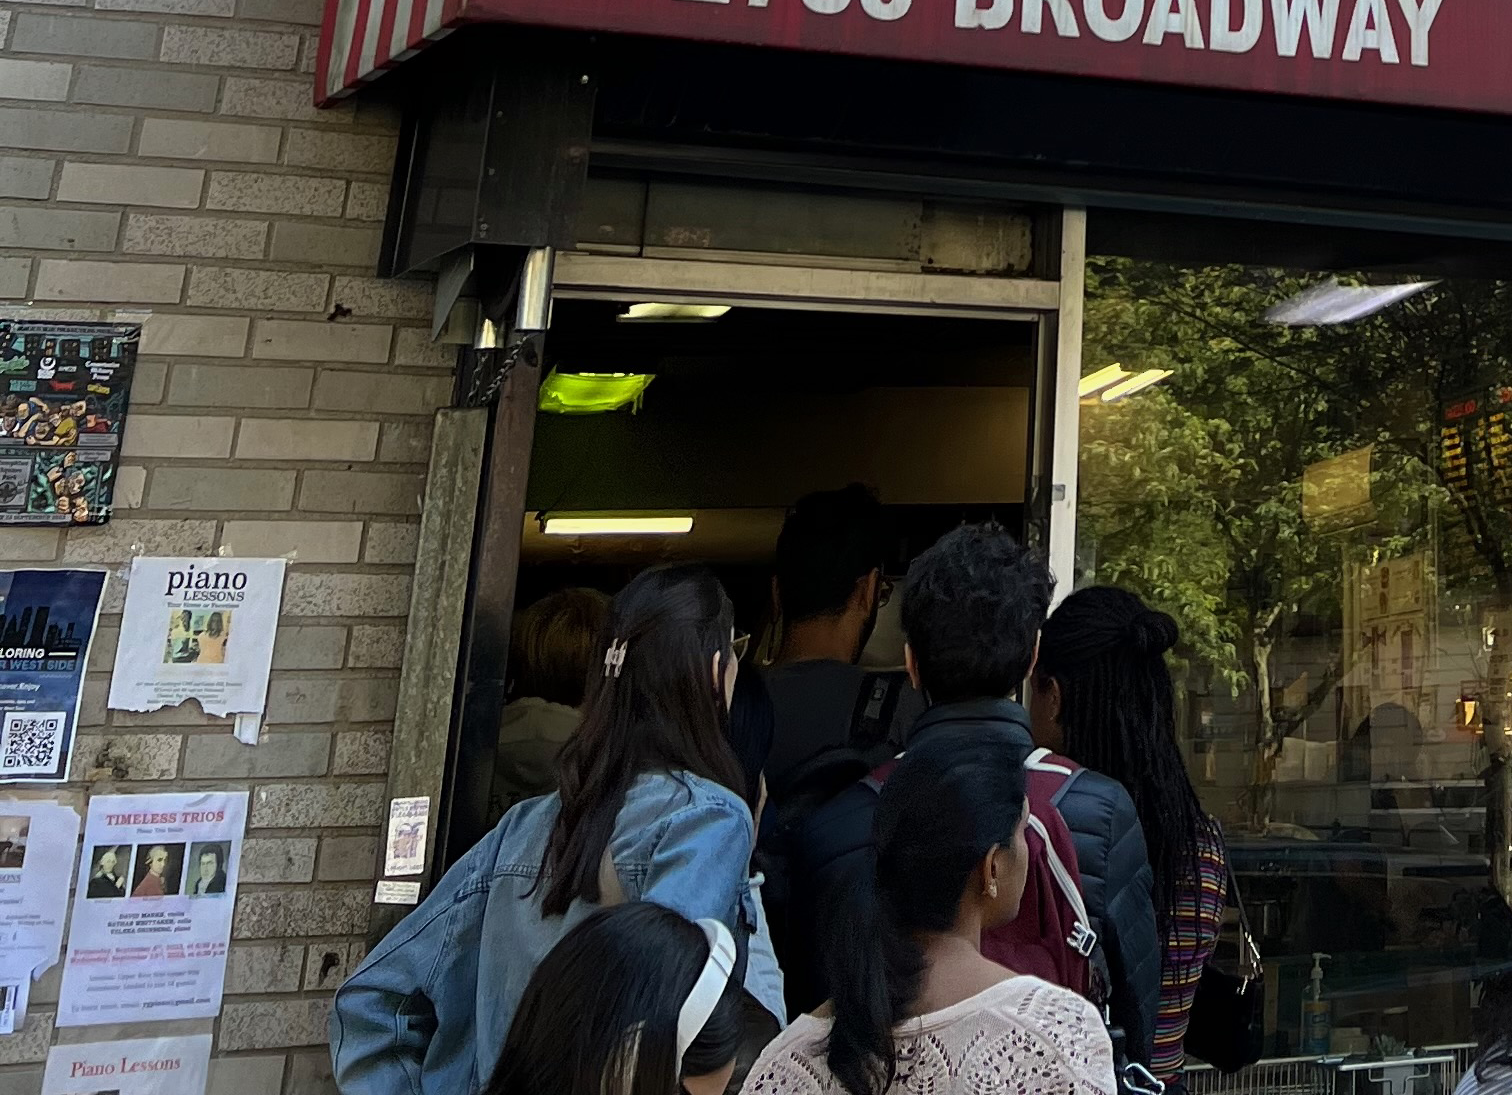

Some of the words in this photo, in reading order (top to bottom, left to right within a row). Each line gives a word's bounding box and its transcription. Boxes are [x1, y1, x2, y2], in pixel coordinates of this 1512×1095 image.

[165, 564, 248, 596] piano
[183, 590, 245, 602] LESSONS
[10, 659, 44, 670] WEST
[47, 659, 75, 670] SIDE
[106, 812, 177, 826] TIMELESS
[181, 810, 224, 824] TRIOS
[70, 1059, 116, 1078] Piano
[120, 1056, 181, 1074] Lessons
